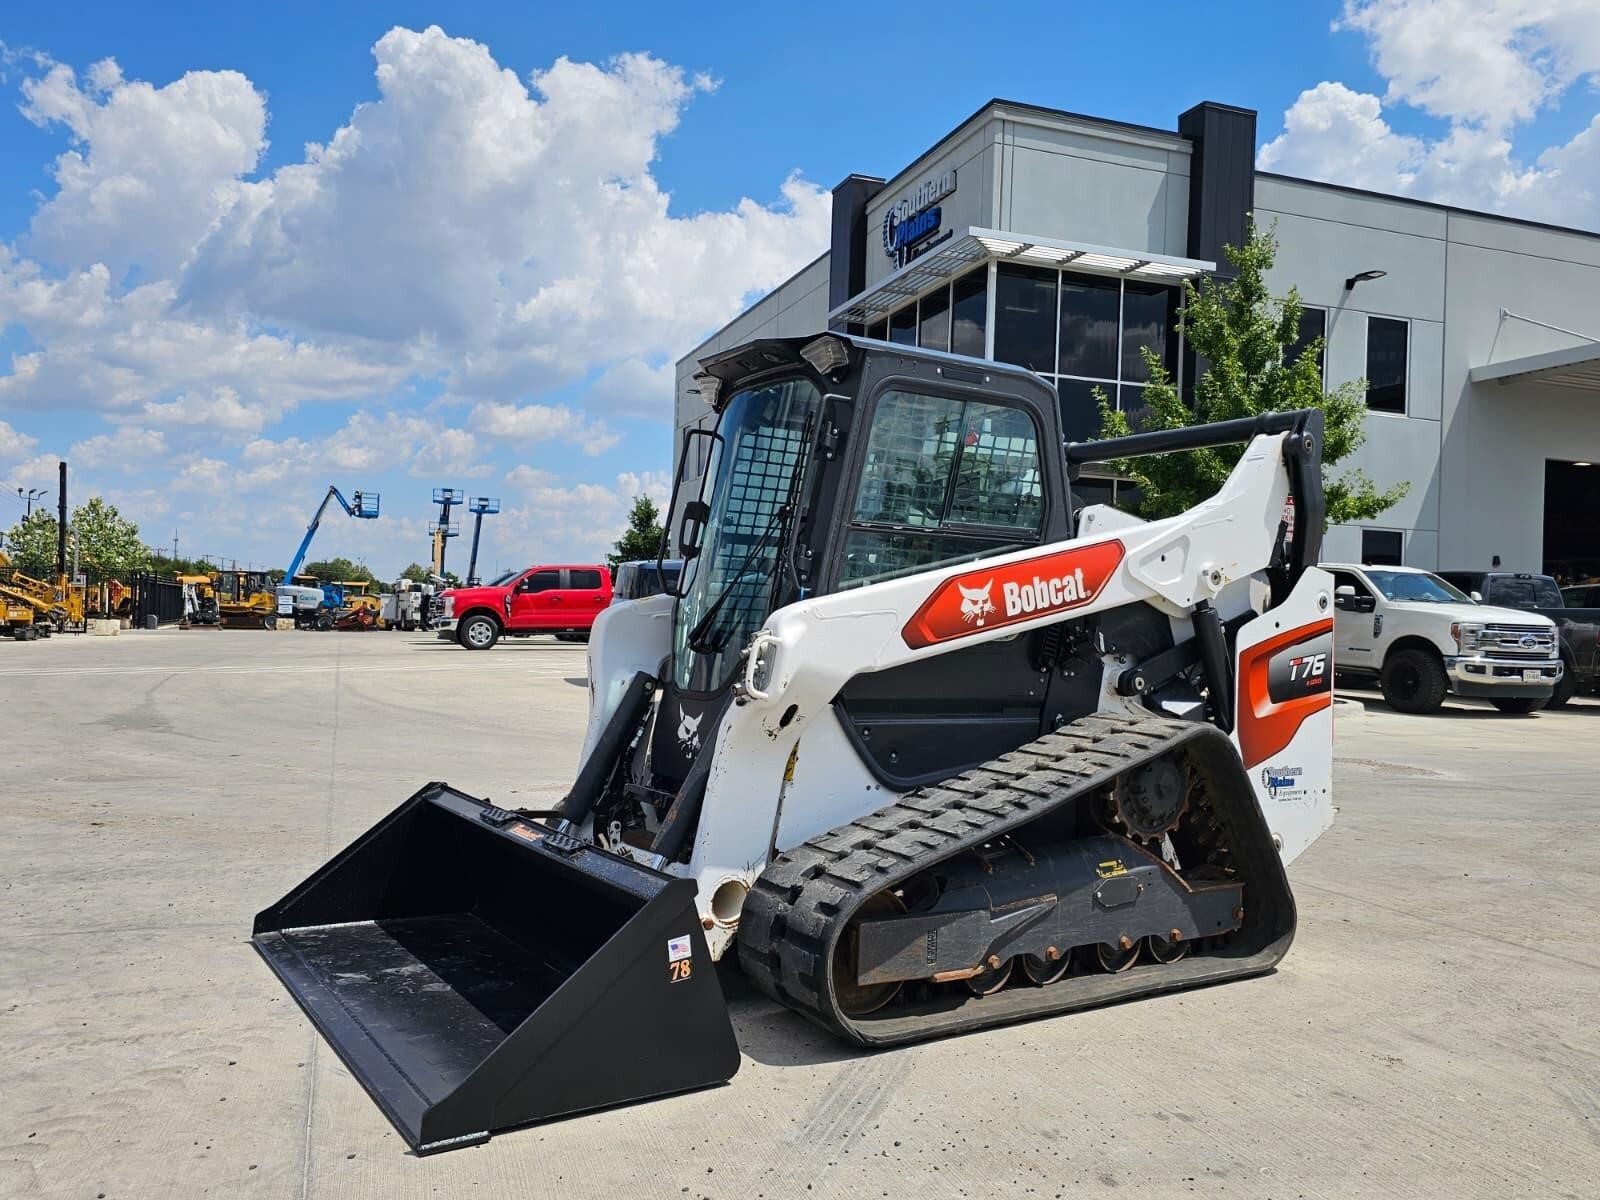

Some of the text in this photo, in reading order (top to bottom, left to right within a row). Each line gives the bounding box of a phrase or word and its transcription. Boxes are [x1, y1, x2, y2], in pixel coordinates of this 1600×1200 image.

[893, 169, 956, 225] Southern
[896, 207, 942, 250] Plains
[1003, 568, 1086, 616] Bobcat
[1289, 653, 1326, 681] T76
[669, 959, 691, 981] 78
